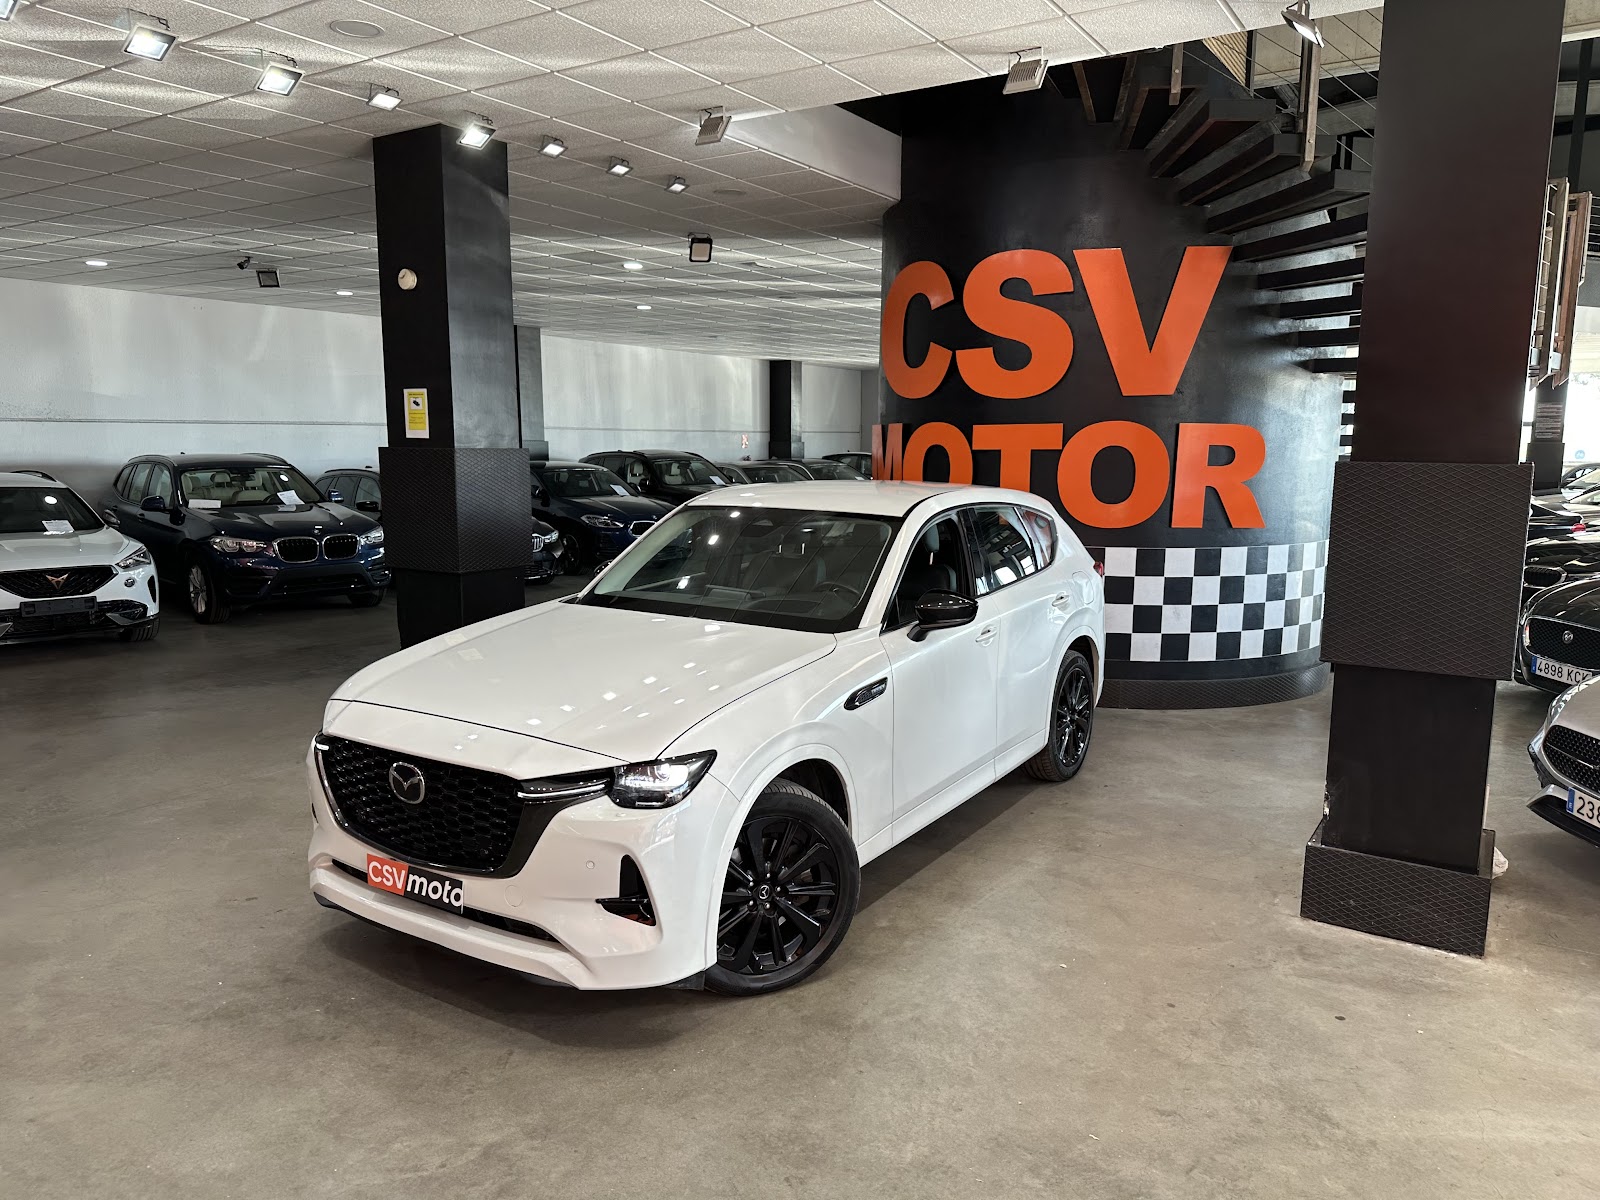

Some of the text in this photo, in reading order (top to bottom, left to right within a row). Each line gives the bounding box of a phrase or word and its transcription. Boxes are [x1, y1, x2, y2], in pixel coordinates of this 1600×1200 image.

[881, 246, 1233, 399] CSV
[872, 420, 1266, 529] MOTOR
[1538, 661, 1563, 678] 4898
